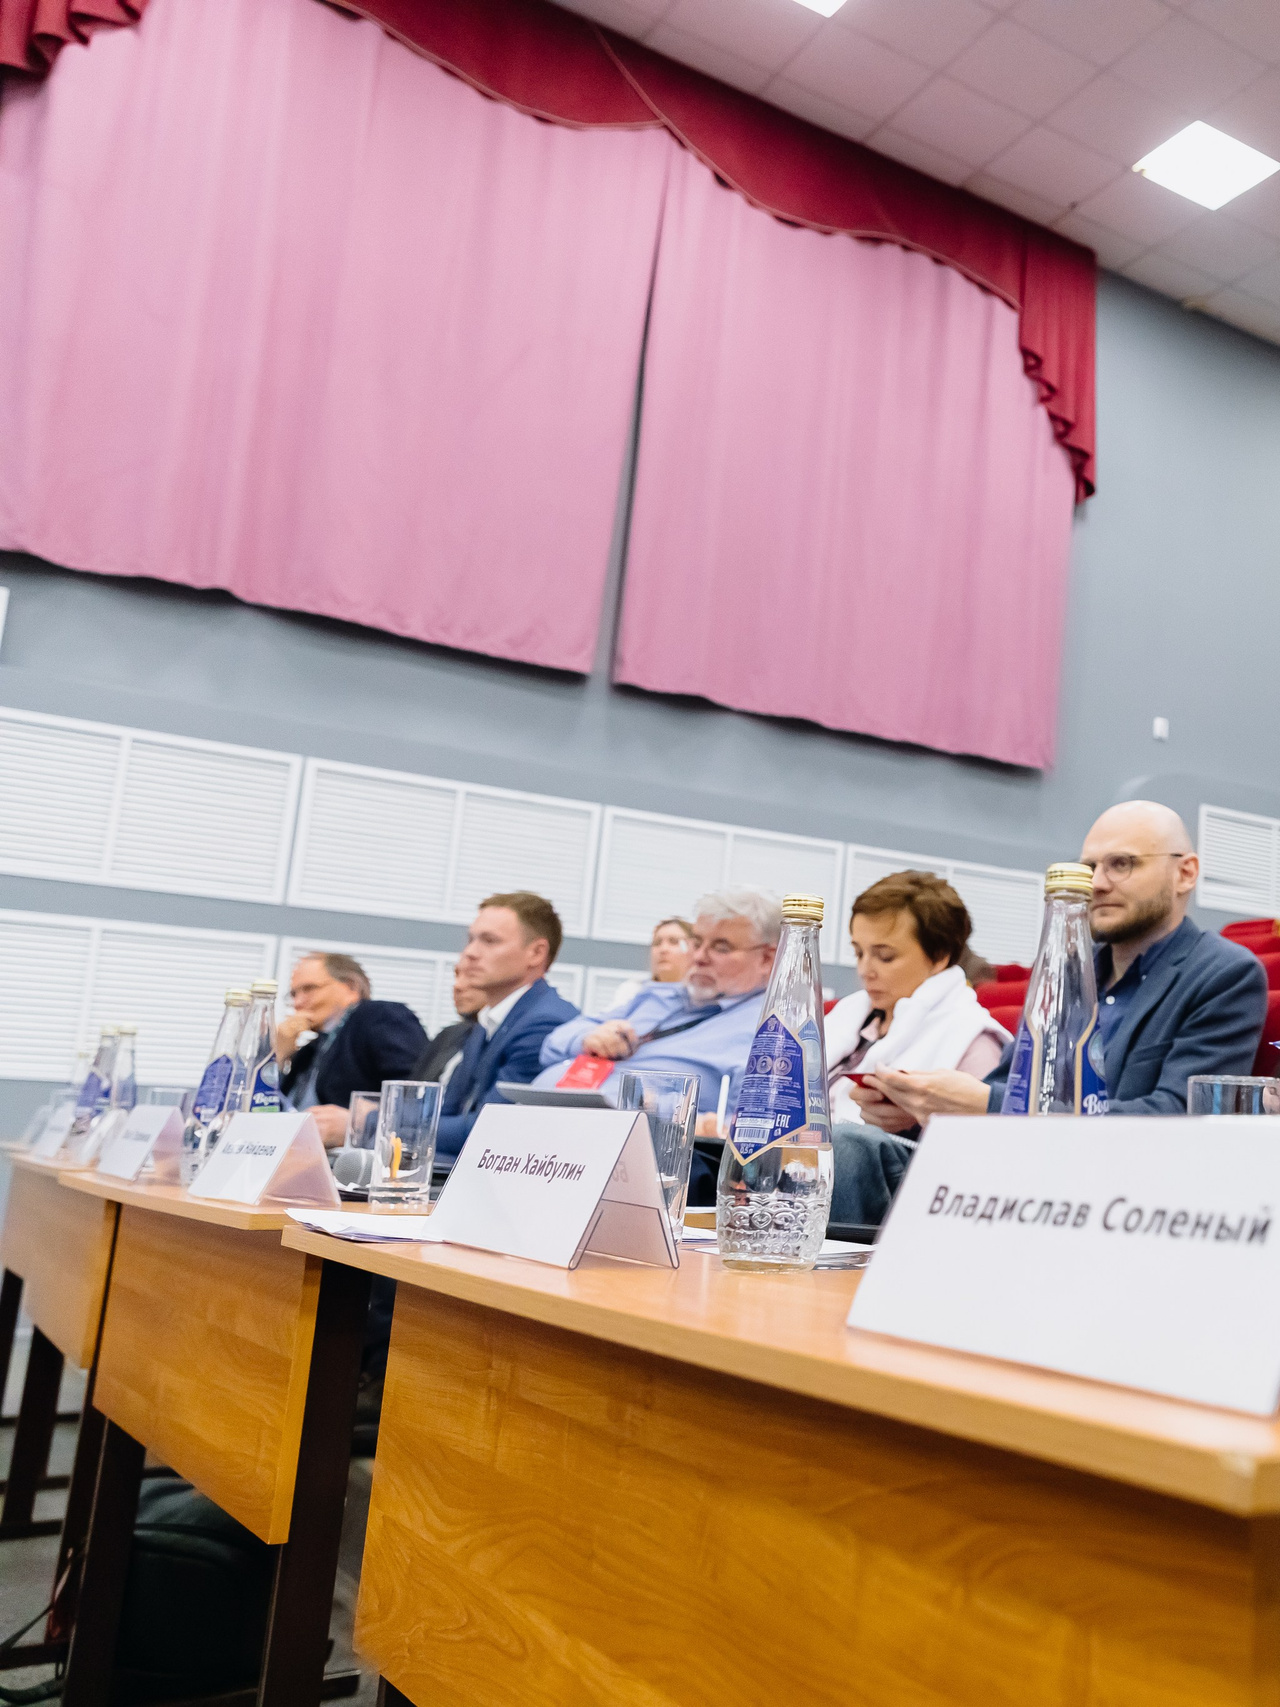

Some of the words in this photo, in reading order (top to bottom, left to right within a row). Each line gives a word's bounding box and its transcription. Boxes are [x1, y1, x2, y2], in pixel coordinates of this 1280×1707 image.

[476, 1148, 522, 1175] Богдан
[520, 1152, 586, 1184] Хайбулин
[926, 1183, 1092, 1229] Владислав
[1101, 1195, 1275, 1247] Соленый
